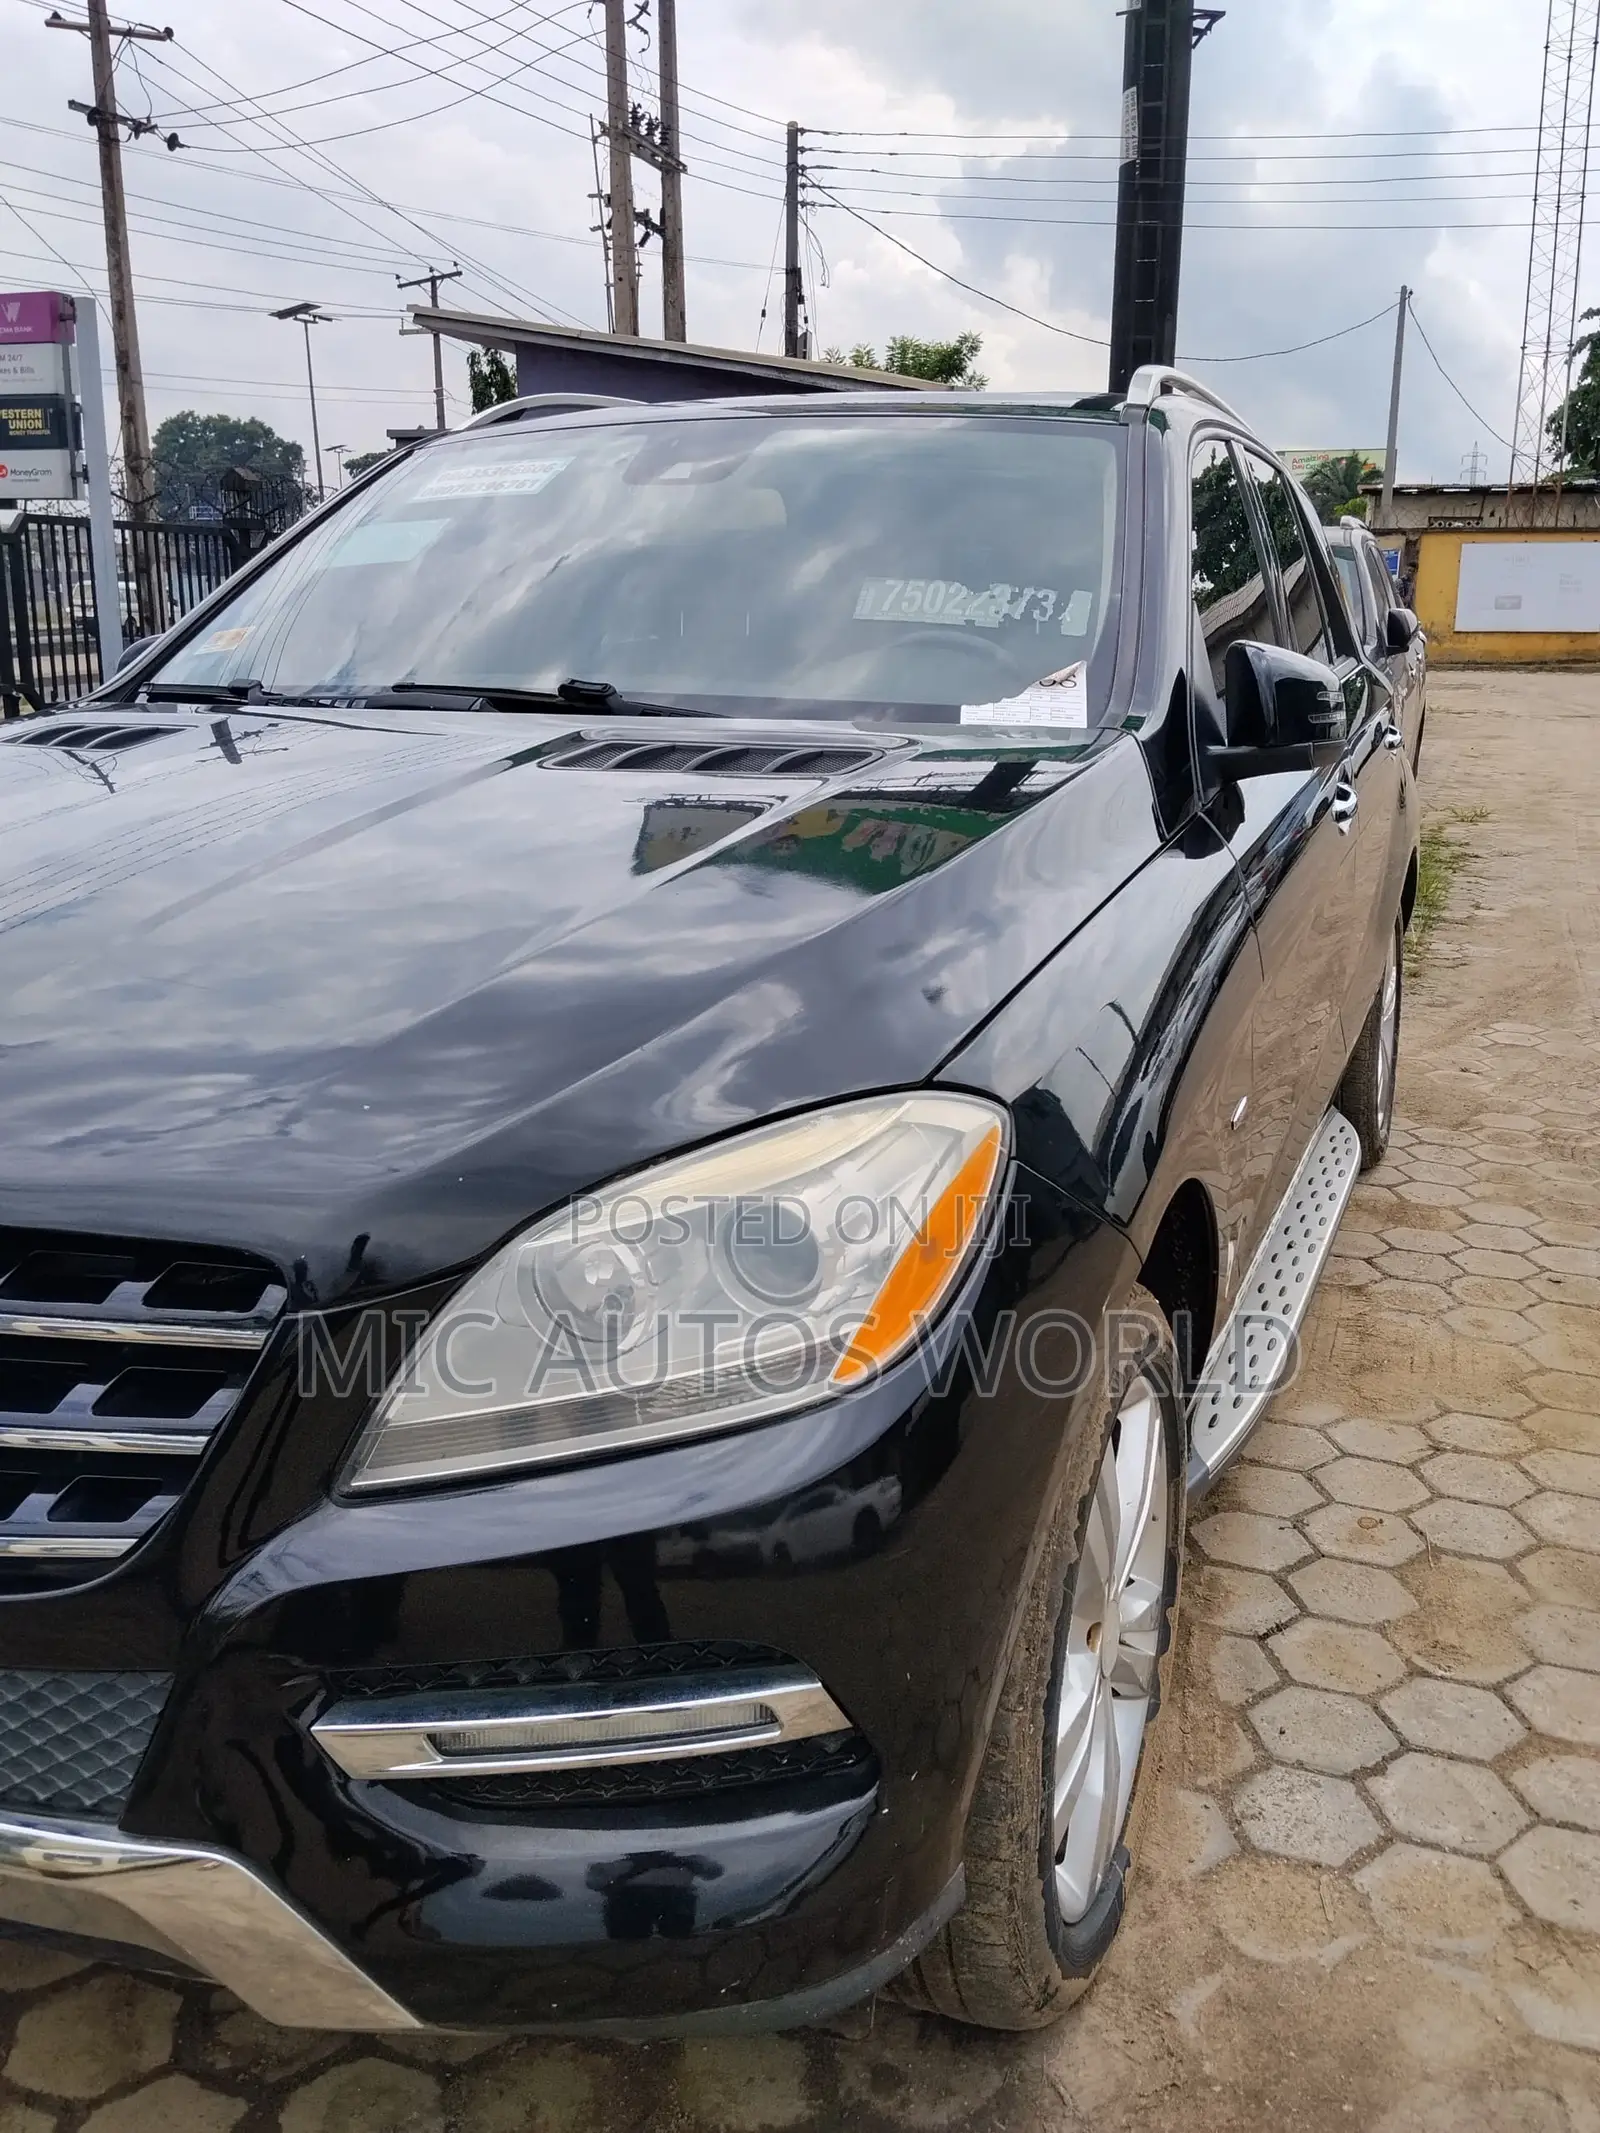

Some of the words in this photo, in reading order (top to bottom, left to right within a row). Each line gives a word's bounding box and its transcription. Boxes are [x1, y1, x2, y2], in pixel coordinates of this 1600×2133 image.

[0, 408, 42, 419] ESTERN
[8, 419, 43, 430] UNION
[10, 467, 53, 478] MoneyGram
